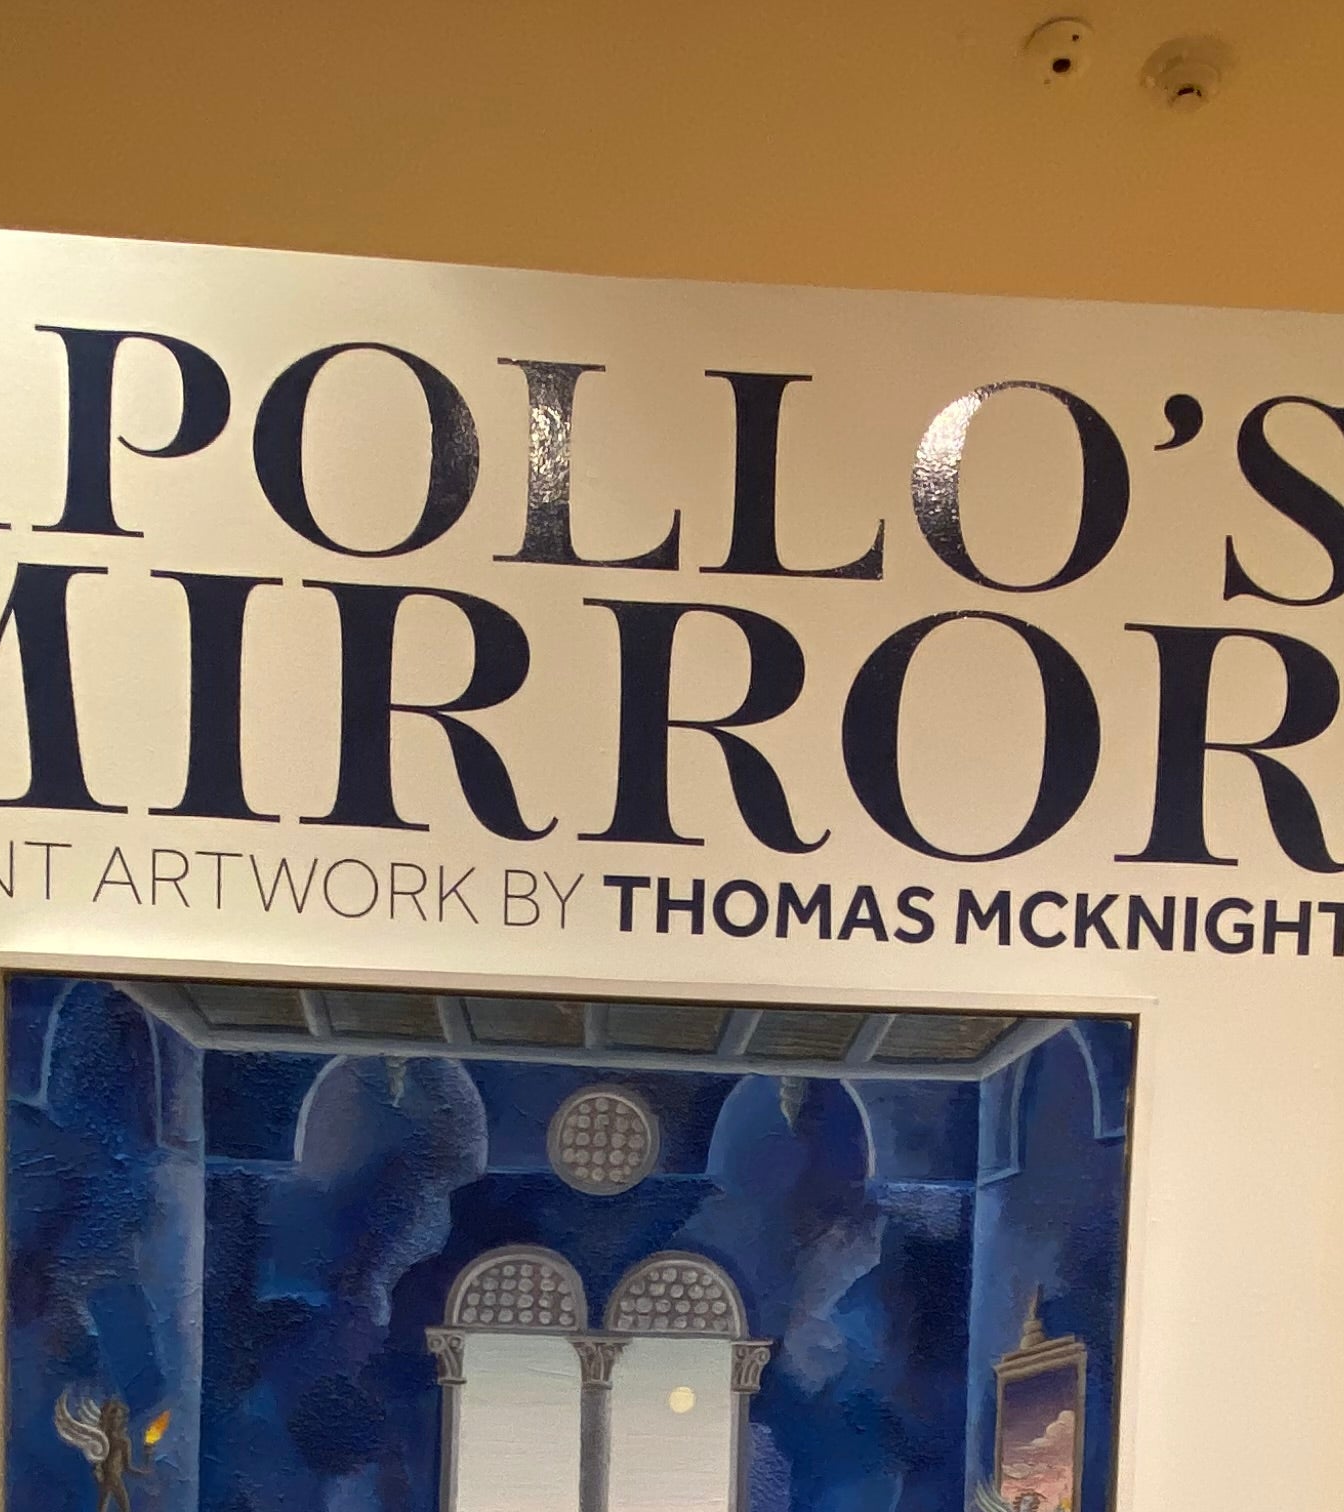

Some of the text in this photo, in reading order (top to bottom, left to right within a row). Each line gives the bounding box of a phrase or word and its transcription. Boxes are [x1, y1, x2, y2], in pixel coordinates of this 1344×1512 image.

[91, 845, 480, 925] ARTWORK
[503, 868, 586, 931] BY
[602, 873, 936, 945] THOMAS
